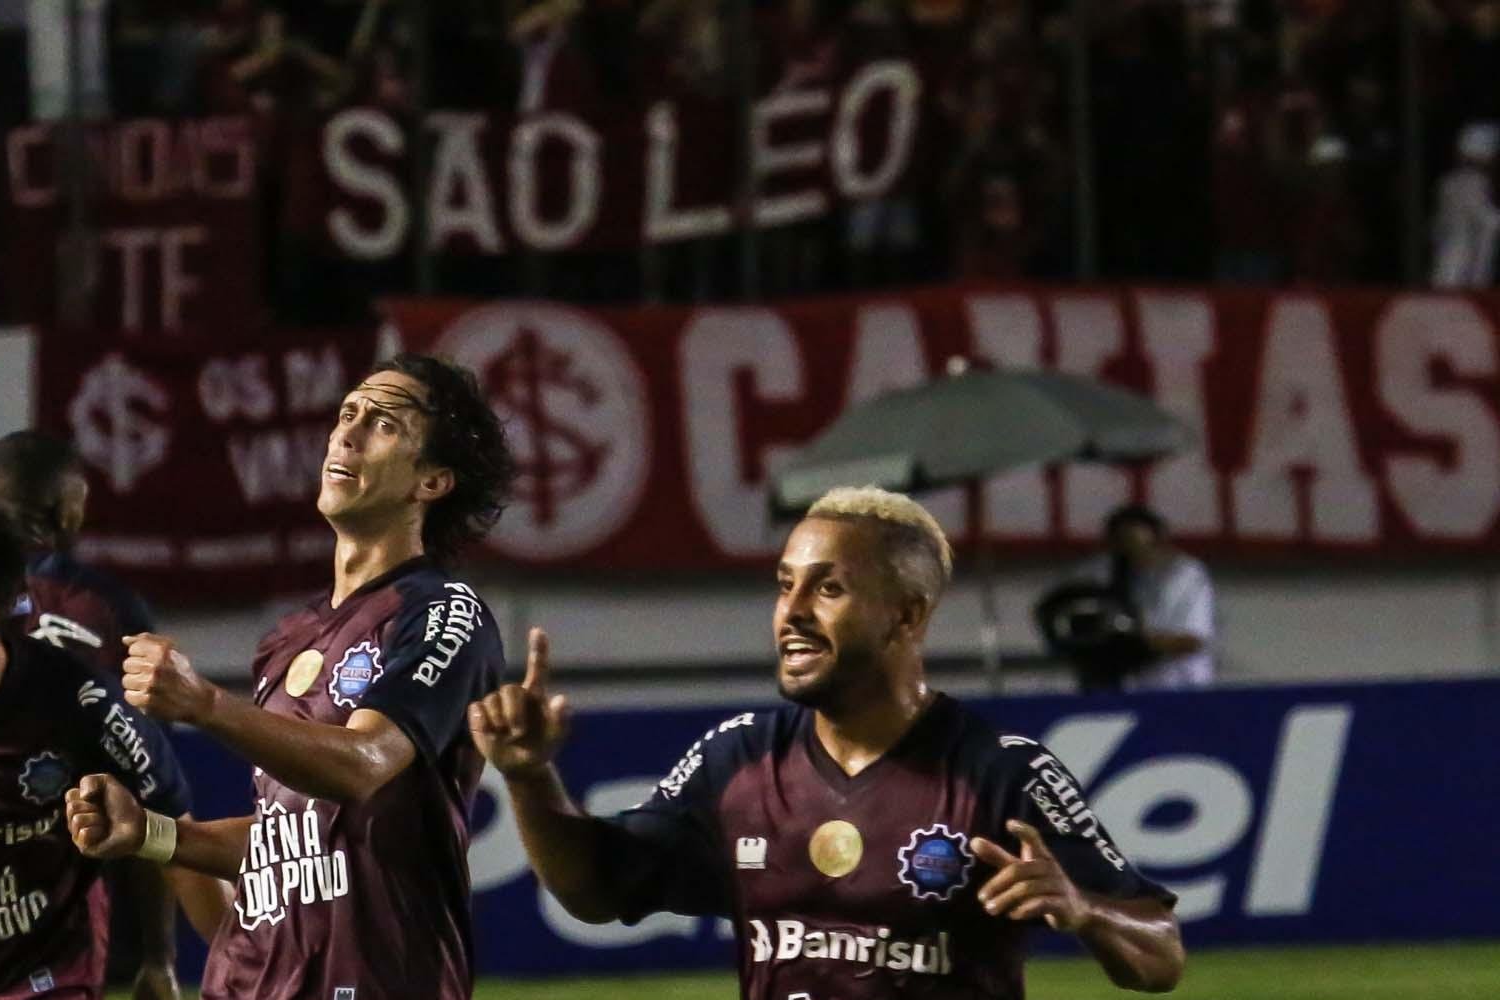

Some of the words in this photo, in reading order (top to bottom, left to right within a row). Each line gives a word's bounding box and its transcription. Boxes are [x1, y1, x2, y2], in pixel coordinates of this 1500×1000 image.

[240, 799, 322, 873] RENÁ
[243, 865, 279, 917] DO
[281, 849, 349, 906] POVO
[775, 919, 951, 976] Banrisul
